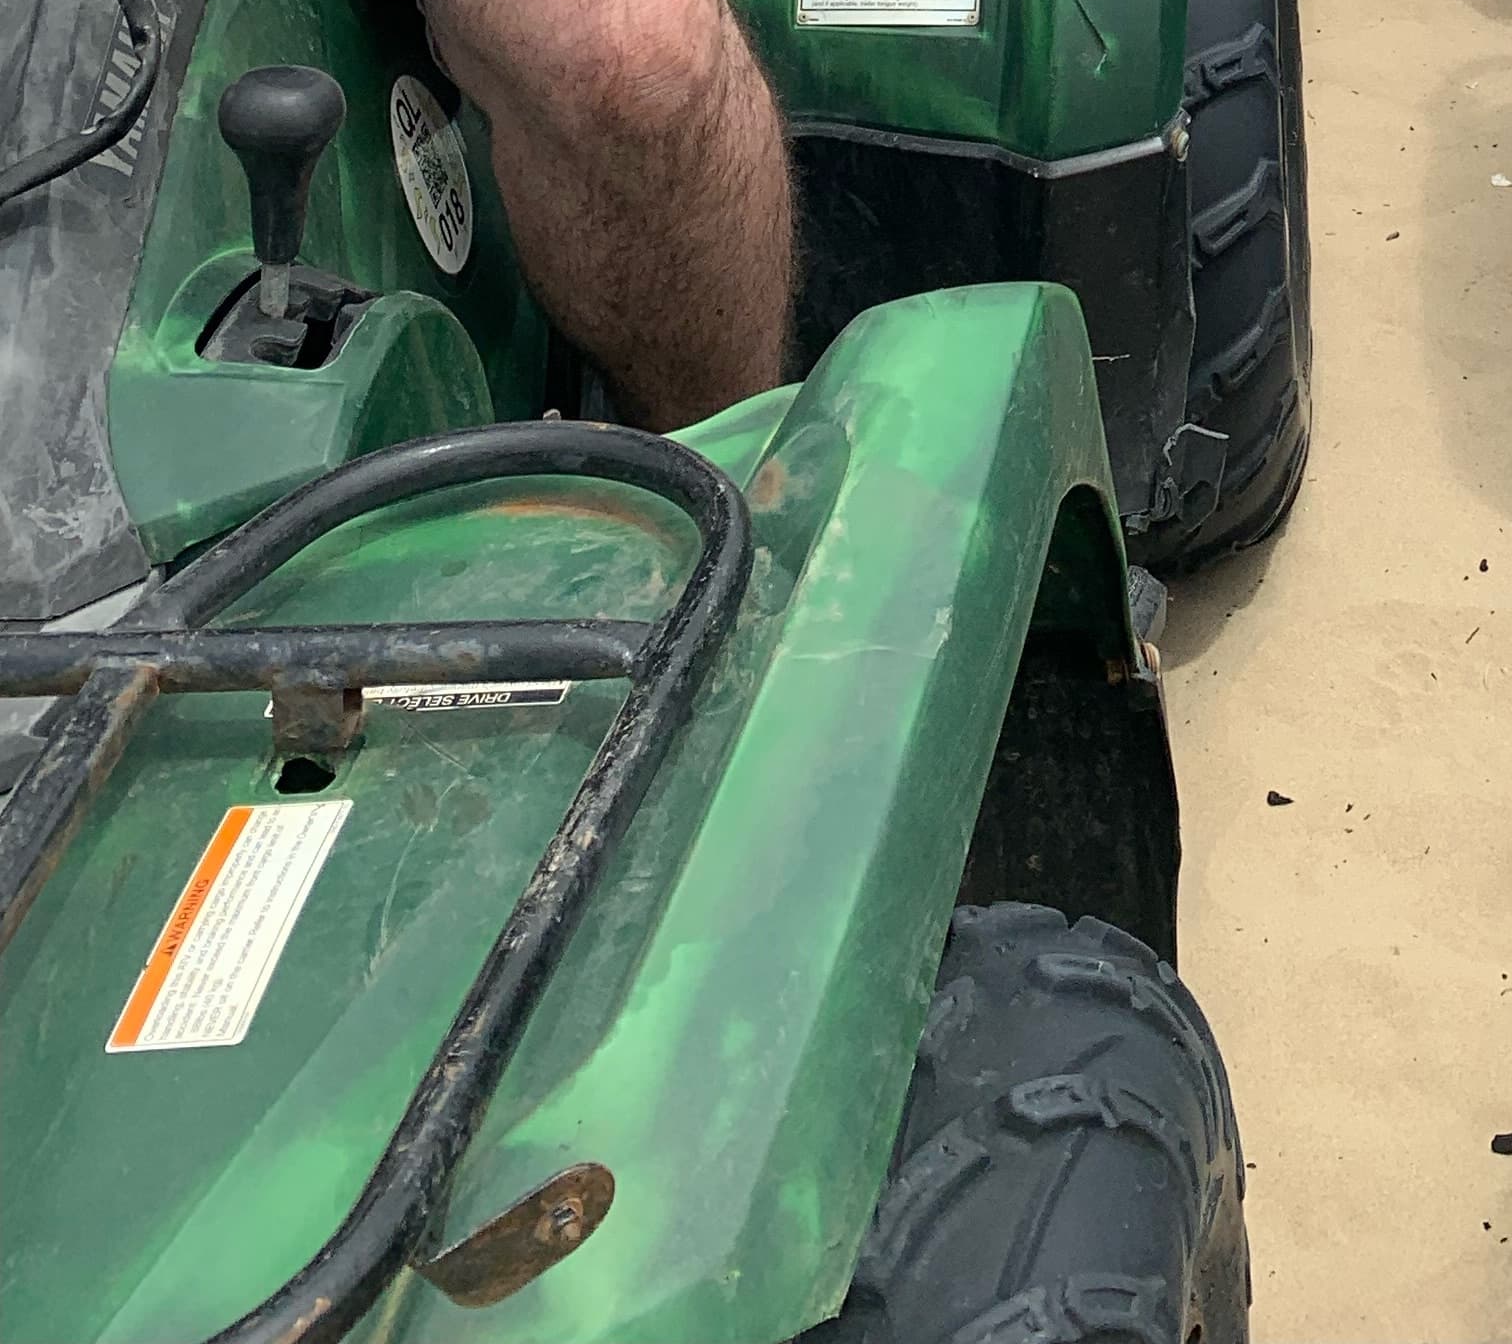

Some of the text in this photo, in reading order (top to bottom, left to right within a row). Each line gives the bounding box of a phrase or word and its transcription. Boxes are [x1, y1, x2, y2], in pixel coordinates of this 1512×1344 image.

[396, 89, 422, 138] QL
[438, 188, 465, 252] 018
[457, 692, 511, 706] DRIVE
[166, 878, 210, 941] WARNING
